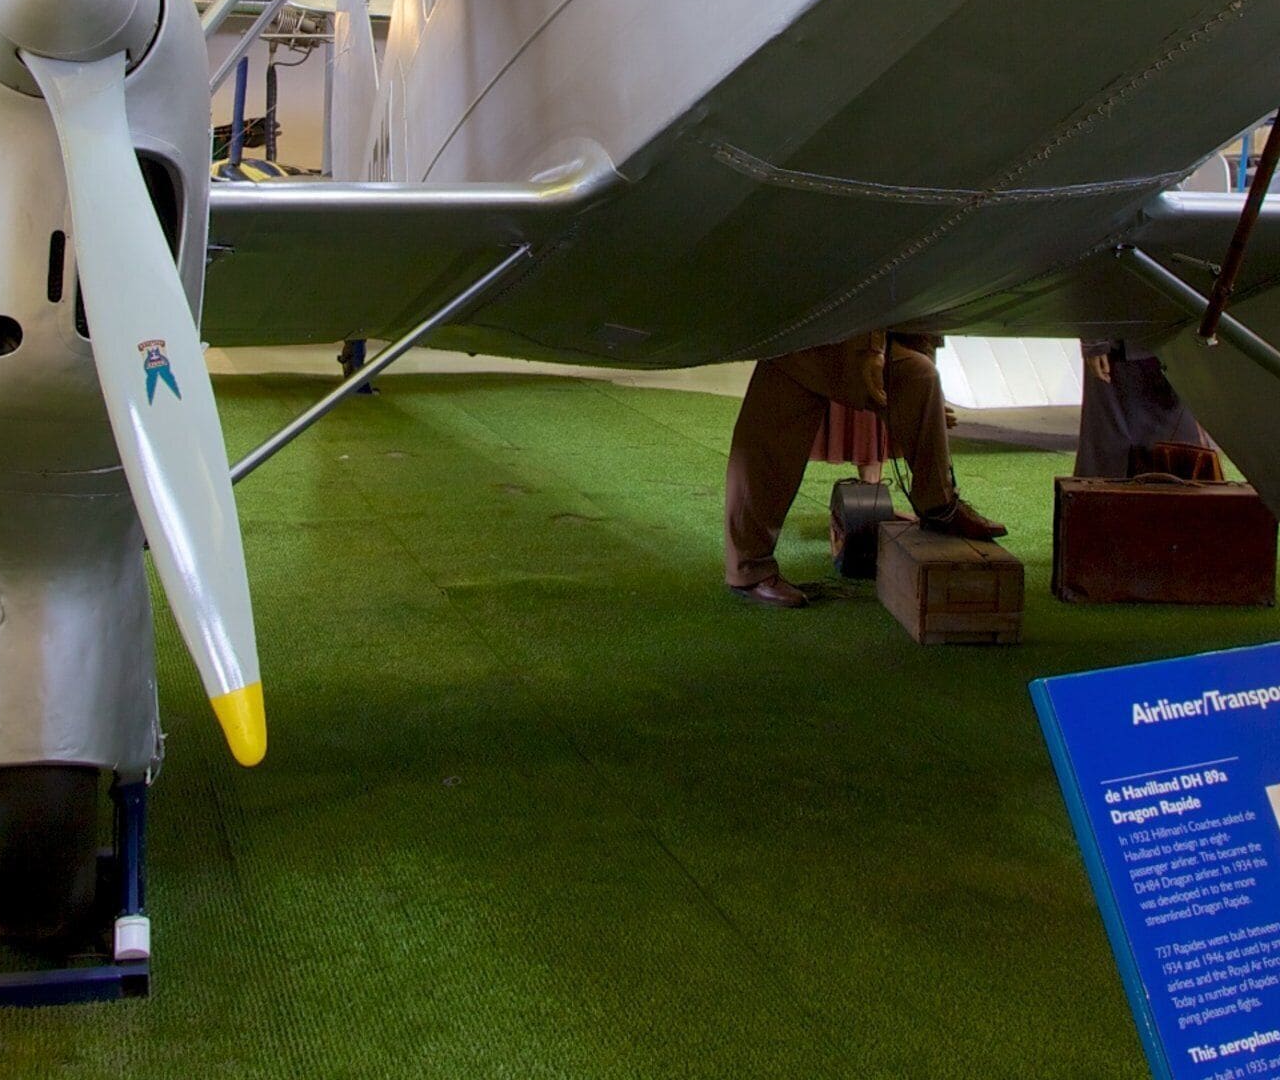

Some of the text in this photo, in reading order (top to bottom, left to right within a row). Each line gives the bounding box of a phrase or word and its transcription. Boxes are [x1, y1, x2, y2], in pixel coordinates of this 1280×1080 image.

[1105, 770, 1228, 803] de Havilland DH 89a
[1110, 796, 1202, 825] Dragon Rapide
[1119, 810, 1256, 846] In 1932 Hillman's Coaches asked de
[1123, 832, 1231, 862] Havilland to design an eight-
[1129, 862, 1169, 880] passenger
[1198, 850, 1217, 862] This
[1217, 845, 1247, 859] became
[1248, 842, 1262, 852] the
[1161, 873, 1194, 888] Dragon
[1221, 865, 1231, 874] In
[1232, 860, 1252, 872] 1934
[1253, 857, 1267, 867] this
[1139, 877, 1256, 910] was developed in to the more
[1144, 894, 1252, 926] streamlined Dragon Rapide.
[1155, 922, 1280, 959] 737 Rapides were built between
[1162, 961, 1183, 975] 1934
[1184, 957, 1200, 970] and
[1202, 952, 1225, 966] 1946
[1225, 948, 1241, 960] and
[1241, 942, 1260, 957] used
[1260, 940, 1270, 953] by
[1168, 977, 1195, 992] airlines
[1196, 972, 1212, 986] and
[1212, 969, 1228, 981] the
[1227, 961, 1250, 977] Royal
[1251, 960, 1262, 971] Air
[1171, 994, 1197, 1009] Today
[1197, 994, 1205, 1003] a
[1205, 985, 1238, 1001] number
[1238, 980, 1248, 993] of
[1248, 975, 1279, 991] Rapides
[1178, 1013, 1202, 1030] giving
[1202, 1002, 1237, 1023] pleasure
[1187, 1044, 1218, 1064] This
[1235, 1067, 1245, 1078] in
[1245, 1058, 1268, 1074] 1935
